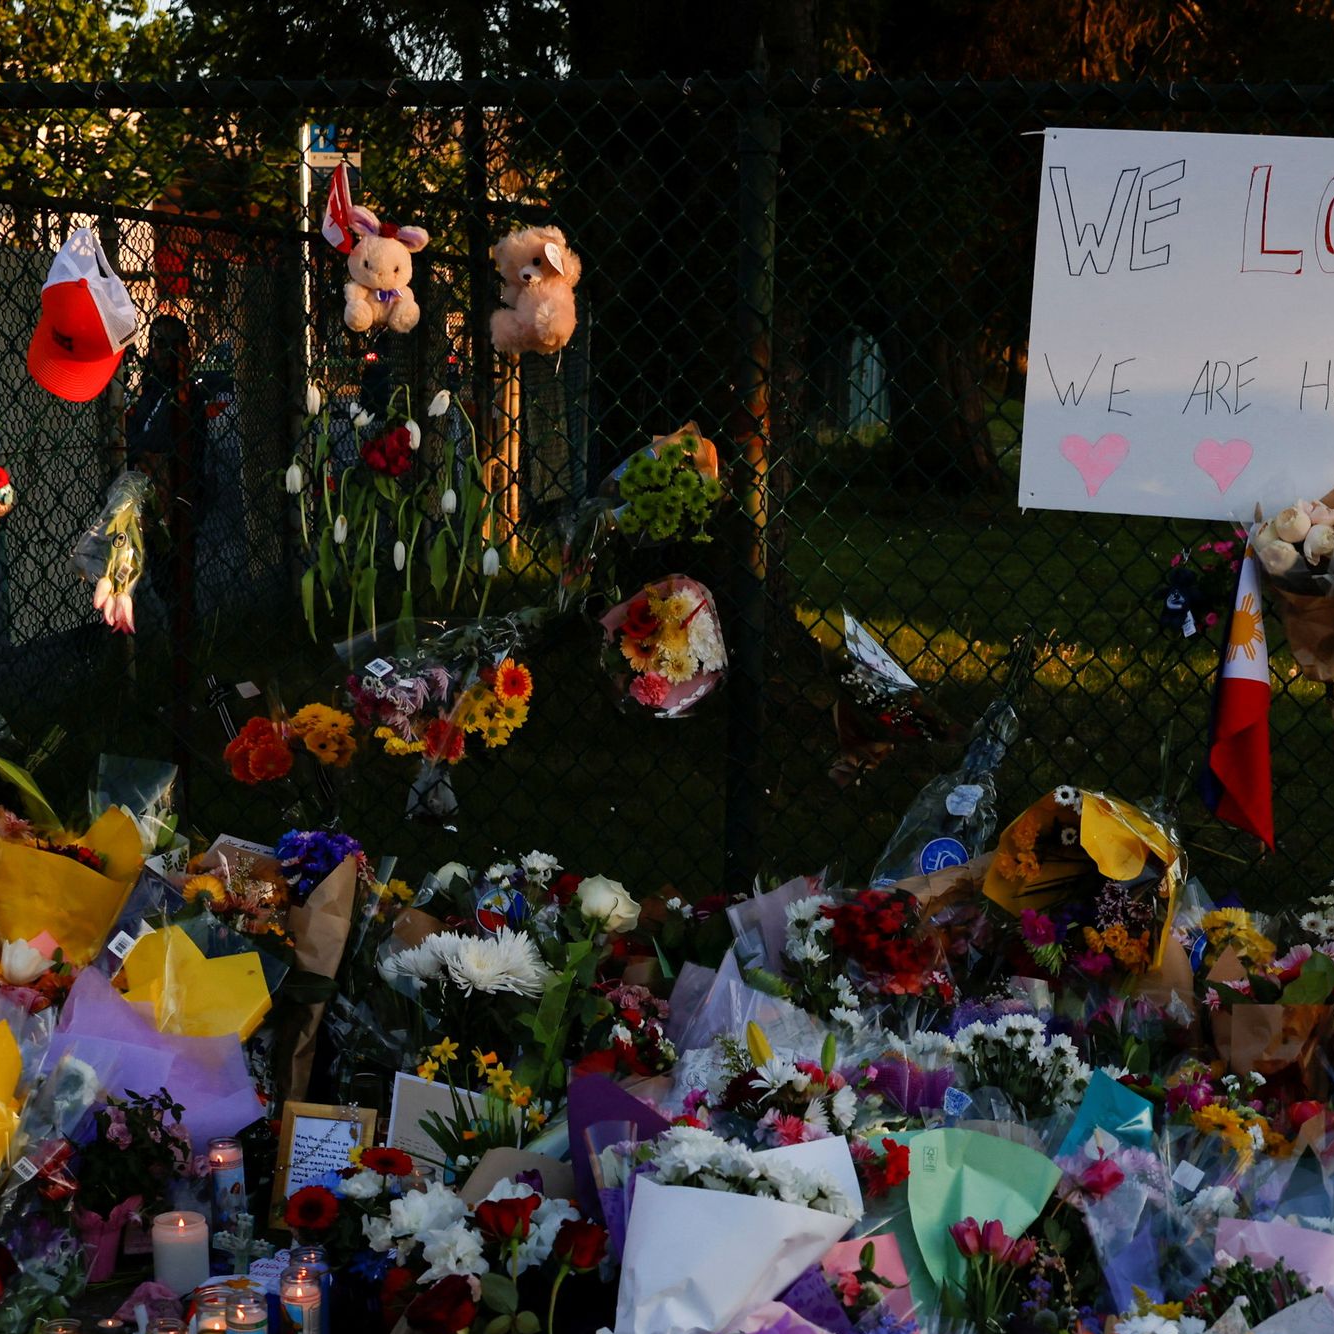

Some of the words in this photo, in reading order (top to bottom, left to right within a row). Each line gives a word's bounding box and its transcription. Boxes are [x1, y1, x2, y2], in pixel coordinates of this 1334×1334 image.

[1049, 159, 1186, 277] WE
[1043, 352, 1137, 417] WE
[1182, 356, 1259, 416] ARE
